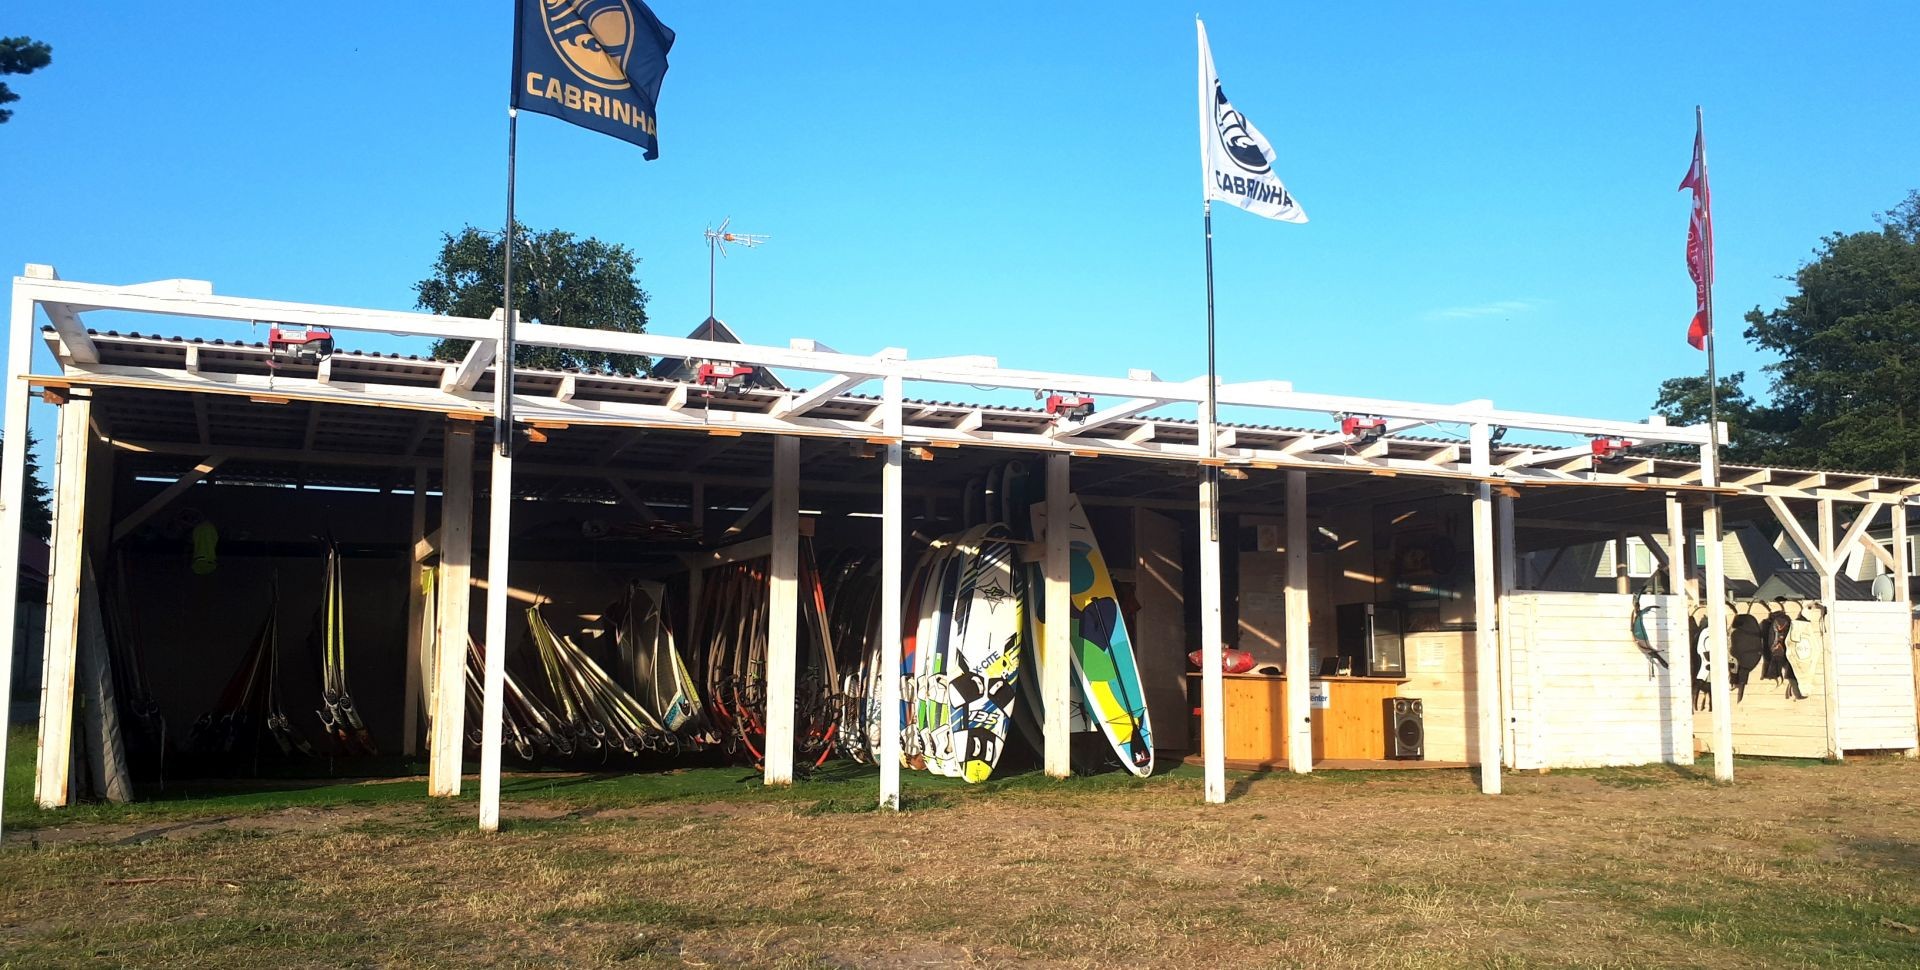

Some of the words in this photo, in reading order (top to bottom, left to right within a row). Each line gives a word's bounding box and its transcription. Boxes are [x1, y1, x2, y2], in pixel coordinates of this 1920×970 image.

[526, 71, 657, 137] CABRINHA
[973, 650, 1001, 675] X-CITE
[1310, 694, 1328, 702] enter
[968, 710, 999, 726] 135
